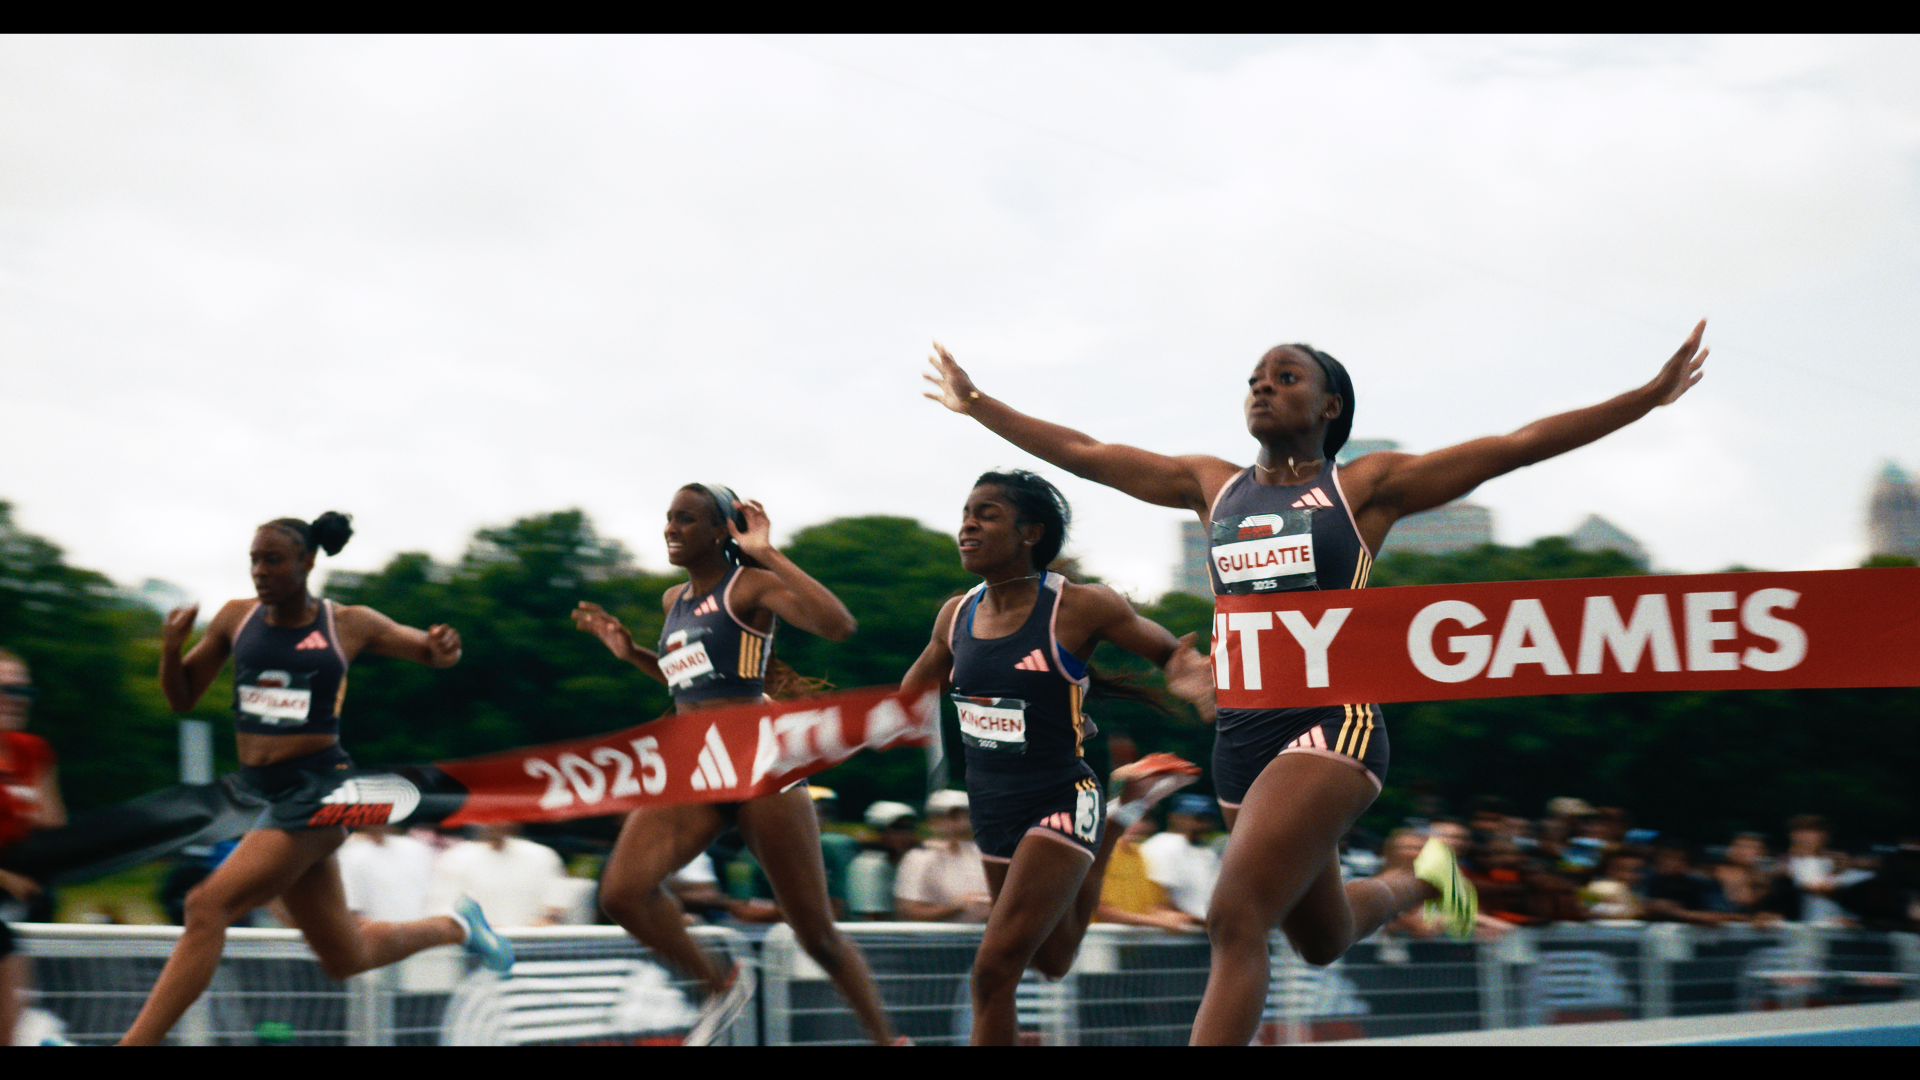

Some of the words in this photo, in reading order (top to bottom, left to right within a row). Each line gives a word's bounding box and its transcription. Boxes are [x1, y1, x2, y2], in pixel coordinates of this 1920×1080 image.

[1218, 545, 1310, 572] GULLATTE
[1211, 608, 1354, 690] ITY
[1407, 588, 1808, 683] GAMES
[960, 709, 1022, 732] KINCHEN
[524, 736, 667, 811] 2025
[1081, 791, 1096, 833] 3
